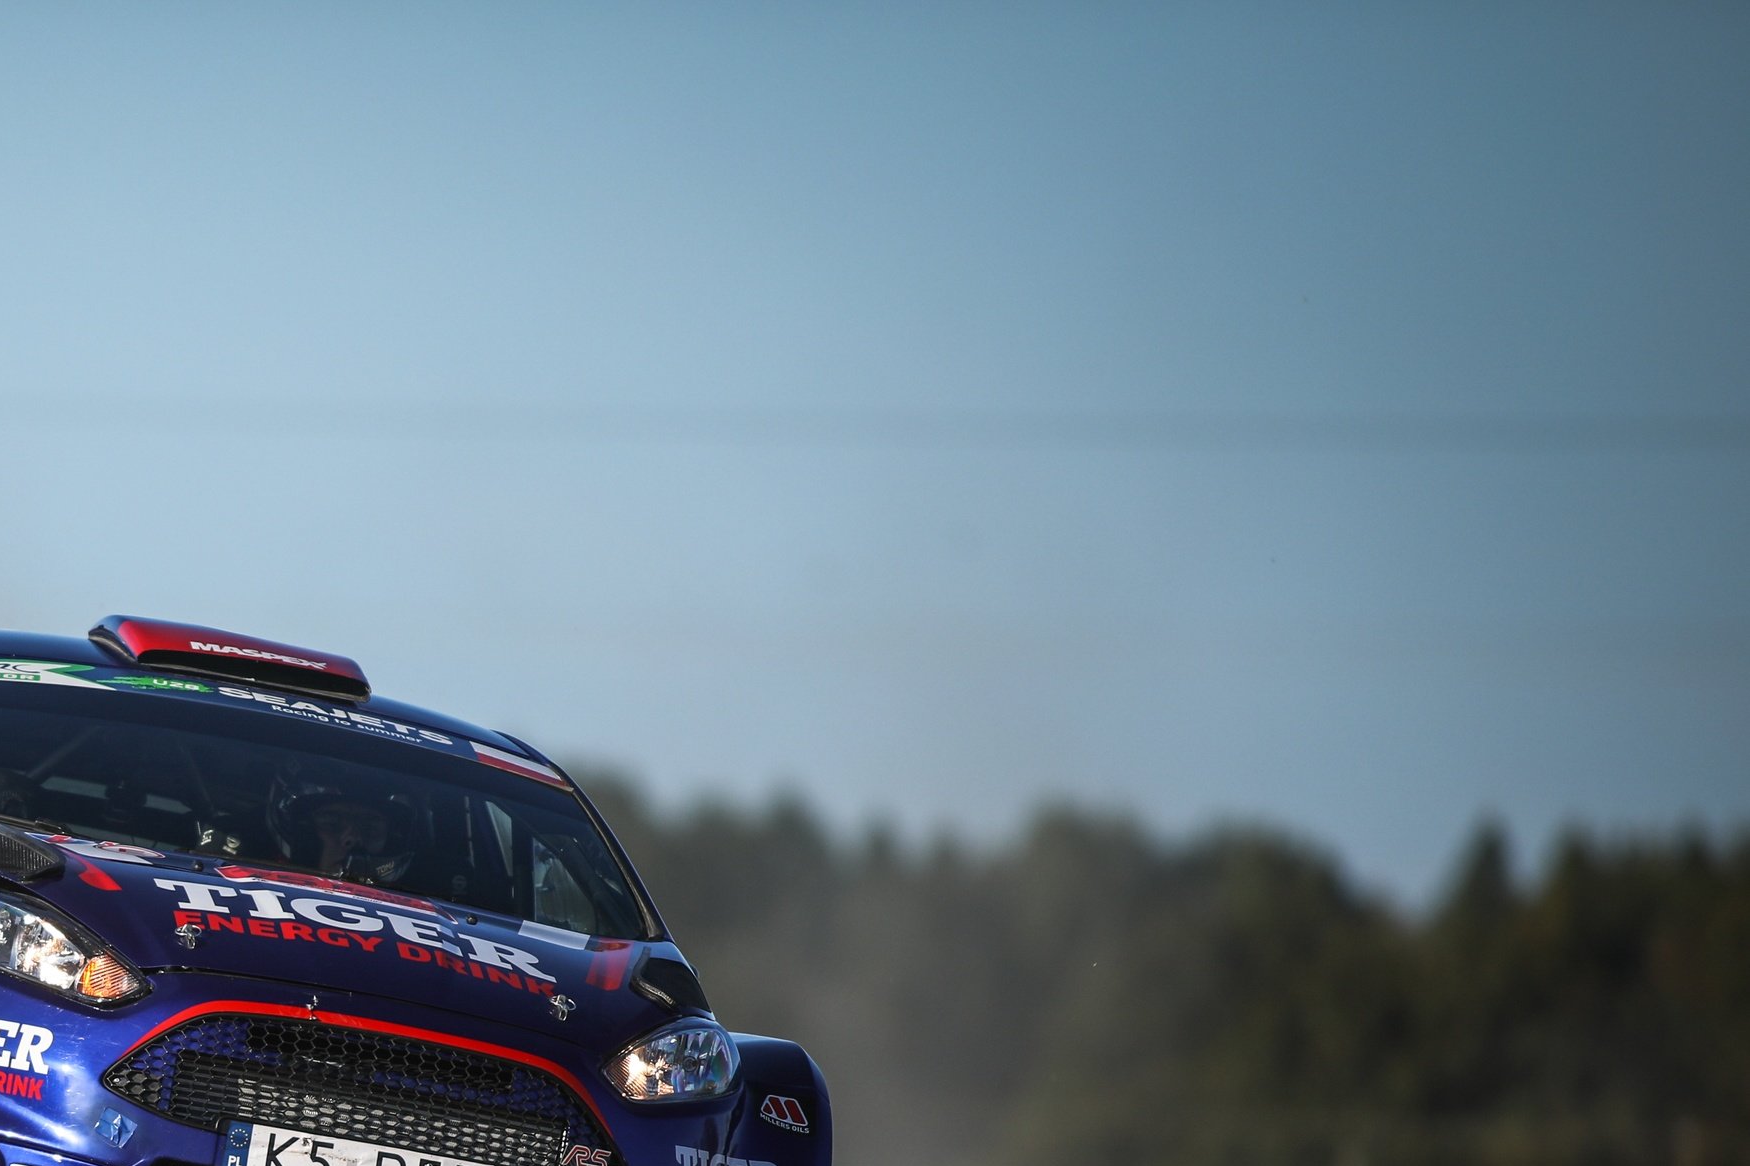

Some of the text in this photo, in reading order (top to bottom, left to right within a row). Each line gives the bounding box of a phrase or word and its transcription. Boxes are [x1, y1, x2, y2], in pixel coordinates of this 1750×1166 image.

[190, 641, 327, 670] MASPEX
[217, 685, 454, 745] SEAJETS
[271, 704, 423, 744] Racing to summer
[153, 878, 558, 983] TIGER
[172, 910, 556, 998] ENERGY DRINK
[760, 1112, 810, 1134] MILLERS OILS
